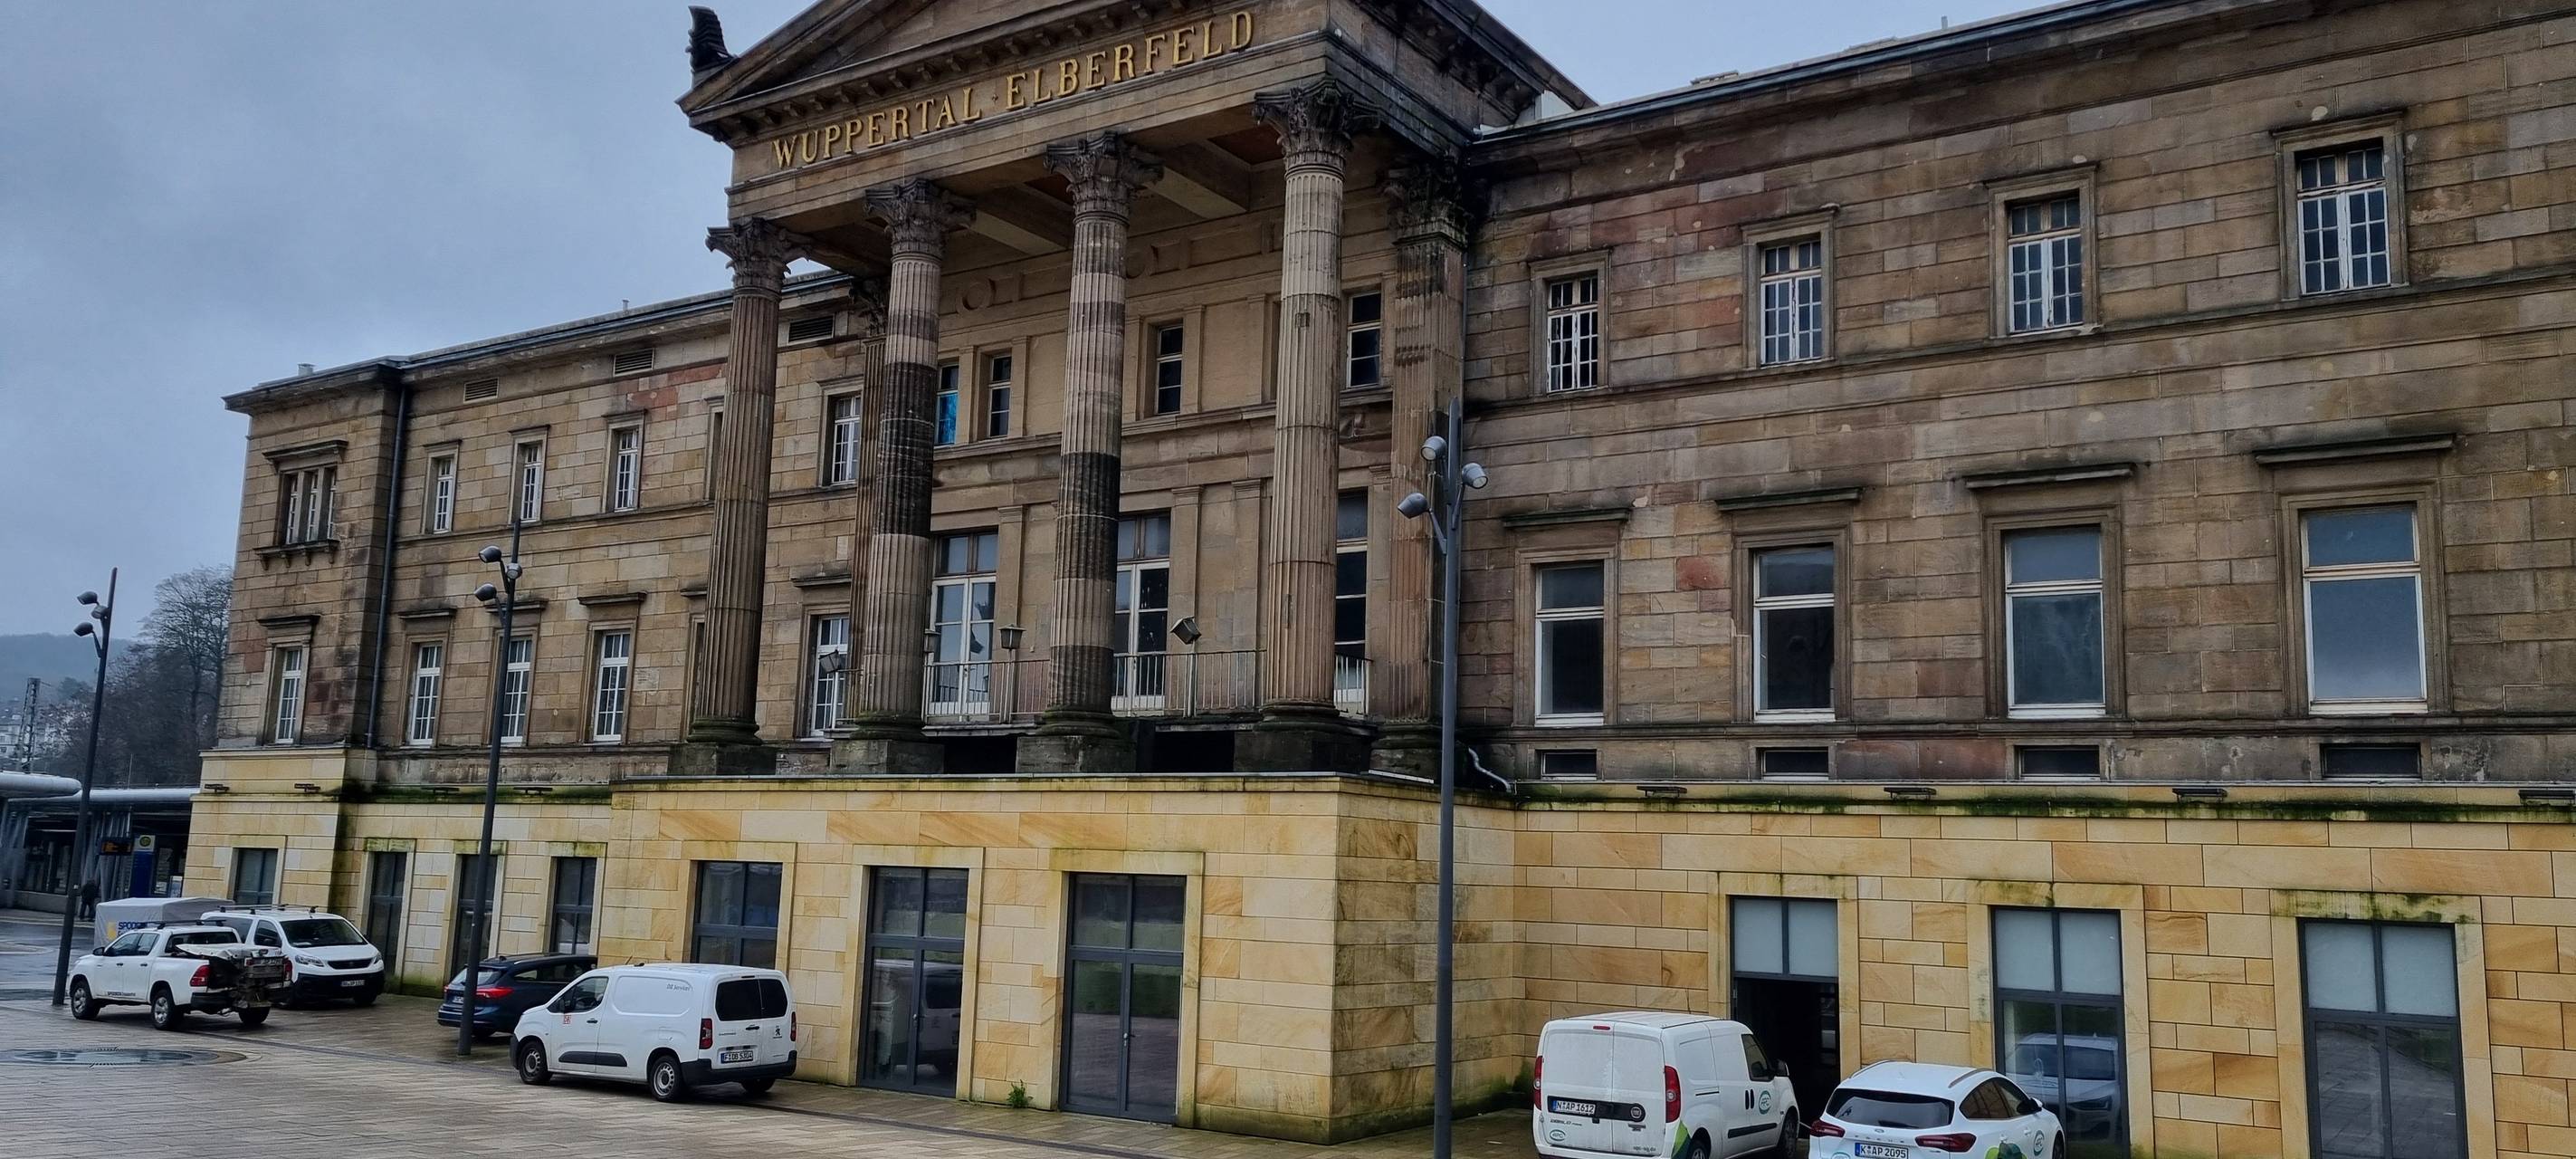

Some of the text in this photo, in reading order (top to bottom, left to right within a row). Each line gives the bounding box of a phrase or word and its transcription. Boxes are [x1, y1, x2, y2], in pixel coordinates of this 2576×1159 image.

[770, 12, 1255, 169] WUPPERTAL ELBERFELD
[1576, 1103, 1595, 1113] 1612
[1872, 1146, 1883, 1155] AP
[1884, 1147, 1906, 1158] 2095
